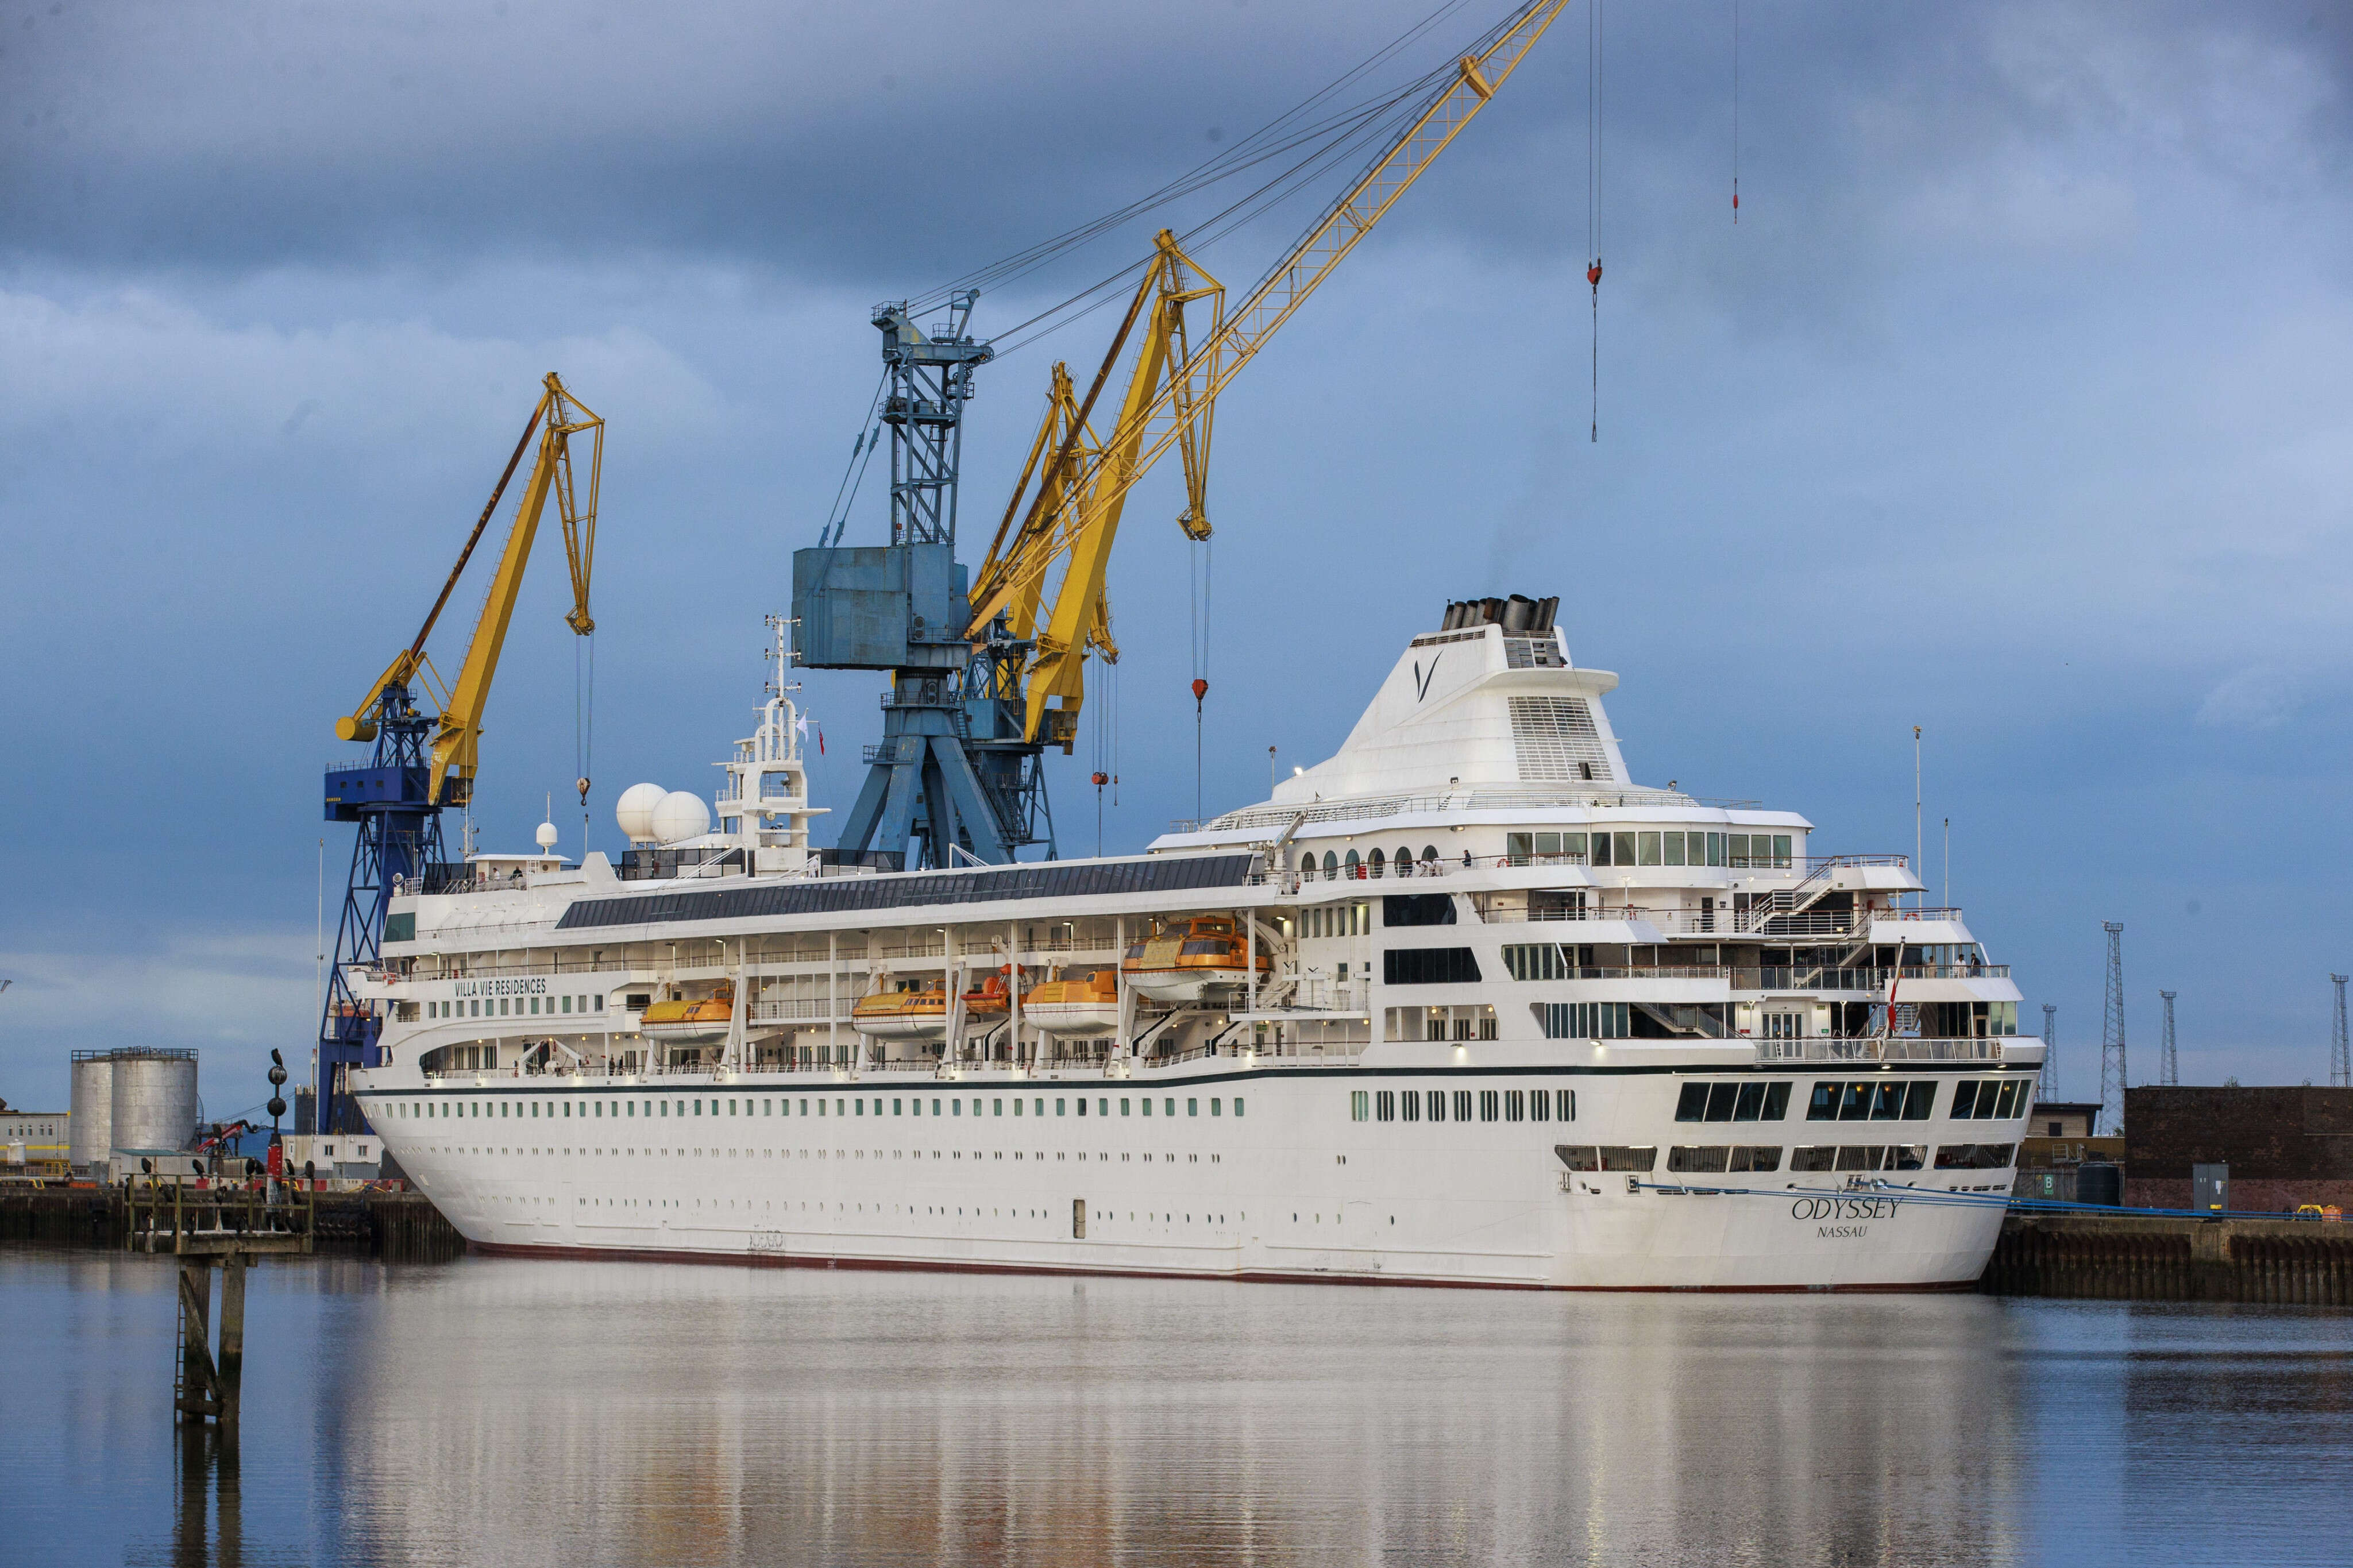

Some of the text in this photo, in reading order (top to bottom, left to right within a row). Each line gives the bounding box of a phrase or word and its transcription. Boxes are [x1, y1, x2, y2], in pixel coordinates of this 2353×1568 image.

[455, 978, 546, 997] VILLA VIE RESIDENCES
[2046, 1177, 2052, 1188] B
[1792, 1198, 1904, 1220] ODYSSEY
[1818, 1226, 1868, 1238] NASSAU
